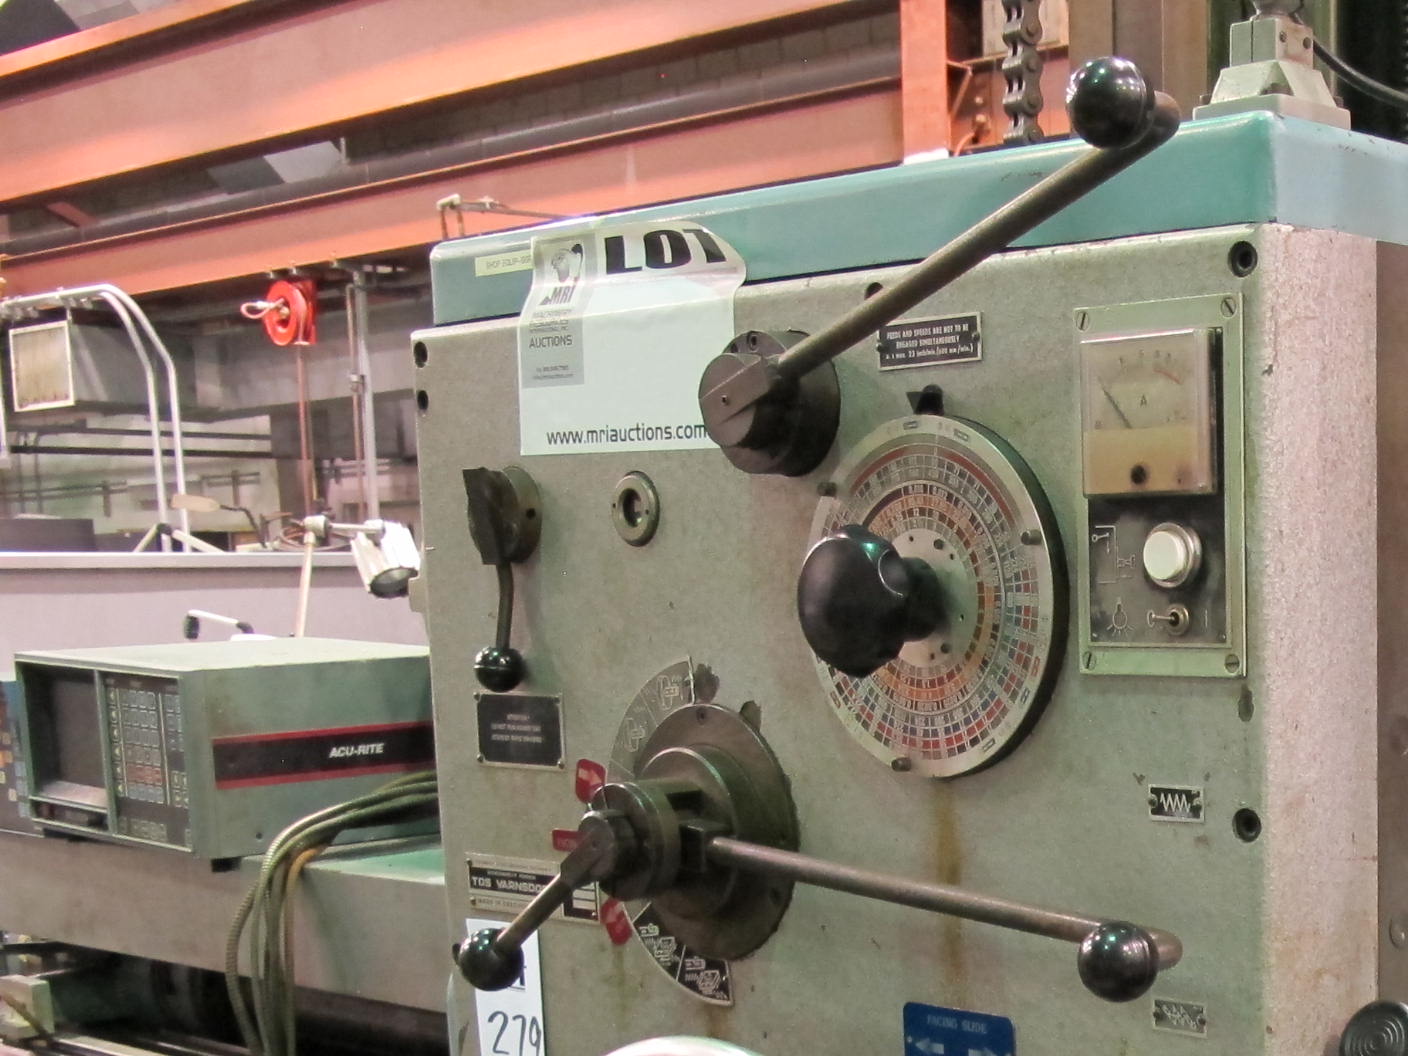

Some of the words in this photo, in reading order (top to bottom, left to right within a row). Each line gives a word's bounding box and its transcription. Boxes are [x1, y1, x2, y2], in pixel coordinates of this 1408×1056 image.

[604, 228, 727, 275] LOT
[902, 329, 912, 338] AND
[932, 326, 942, 334] ARE
[943, 325, 953, 333] NOT
[529, 335, 573, 349] AUCTIONS
[546, 422, 707, 446] www.mriauctions.com
[329, 743, 385, 759] ACU-RITE
[472, 877, 492, 888] TOS
[961, 1019, 988, 1035] SLIDE
